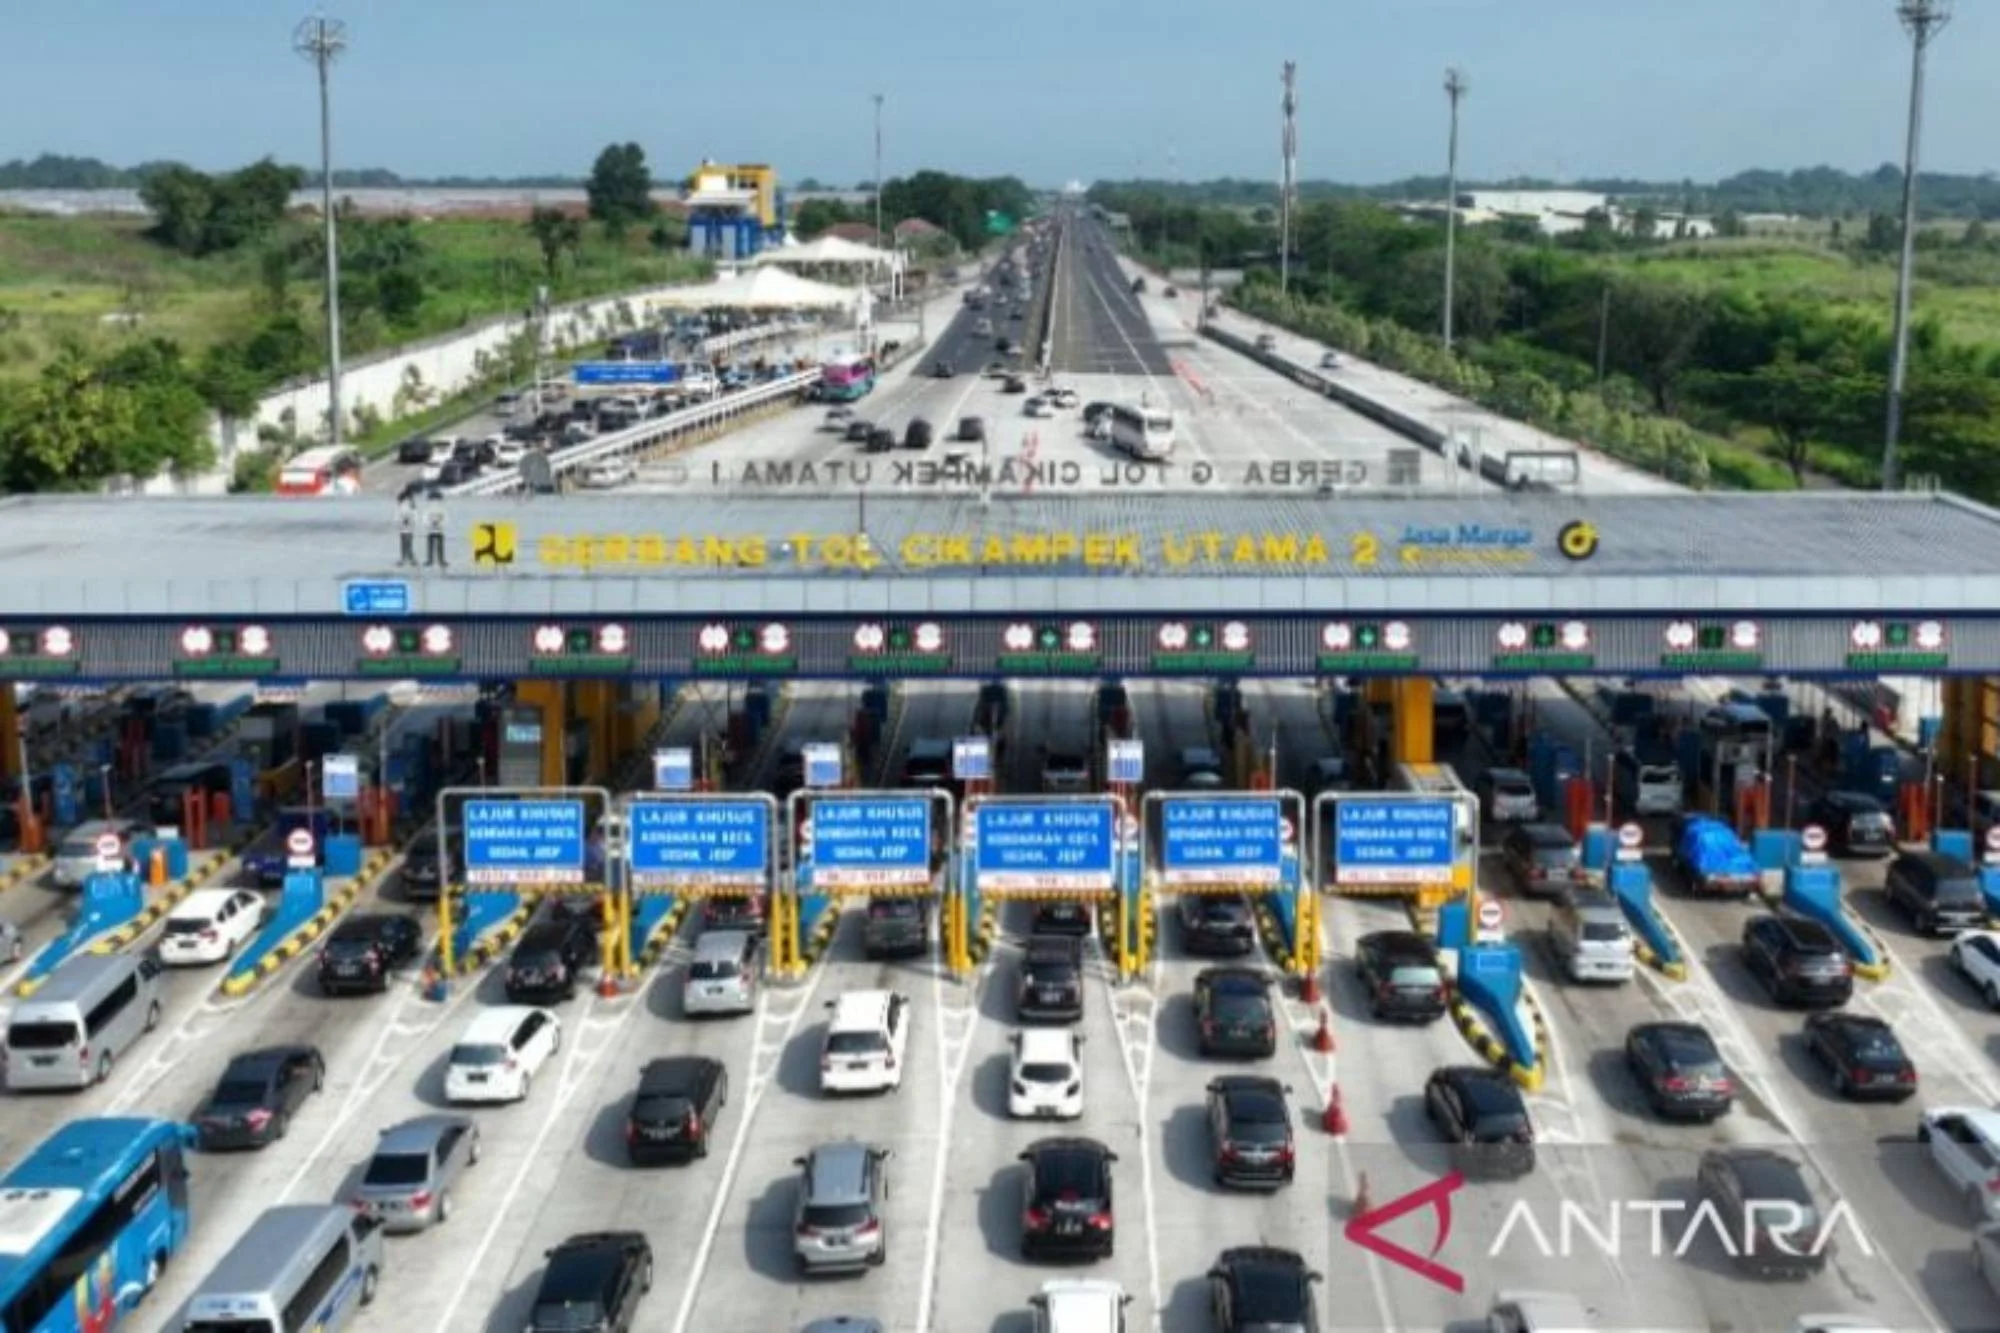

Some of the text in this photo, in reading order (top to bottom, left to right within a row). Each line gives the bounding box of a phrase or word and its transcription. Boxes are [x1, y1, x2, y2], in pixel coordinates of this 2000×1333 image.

[790, 533, 881, 568] TOL
[902, 532, 1141, 568] CIKAMPEK
[1162, 531, 1328, 567] UTAMA
[1352, 532, 1378, 567] 2
[469, 807, 515, 821] LAJUR
[641, 810, 687, 824] LAJUR
[818, 807, 862, 820] LAJUR
[986, 812, 1034, 827] LAJUR
